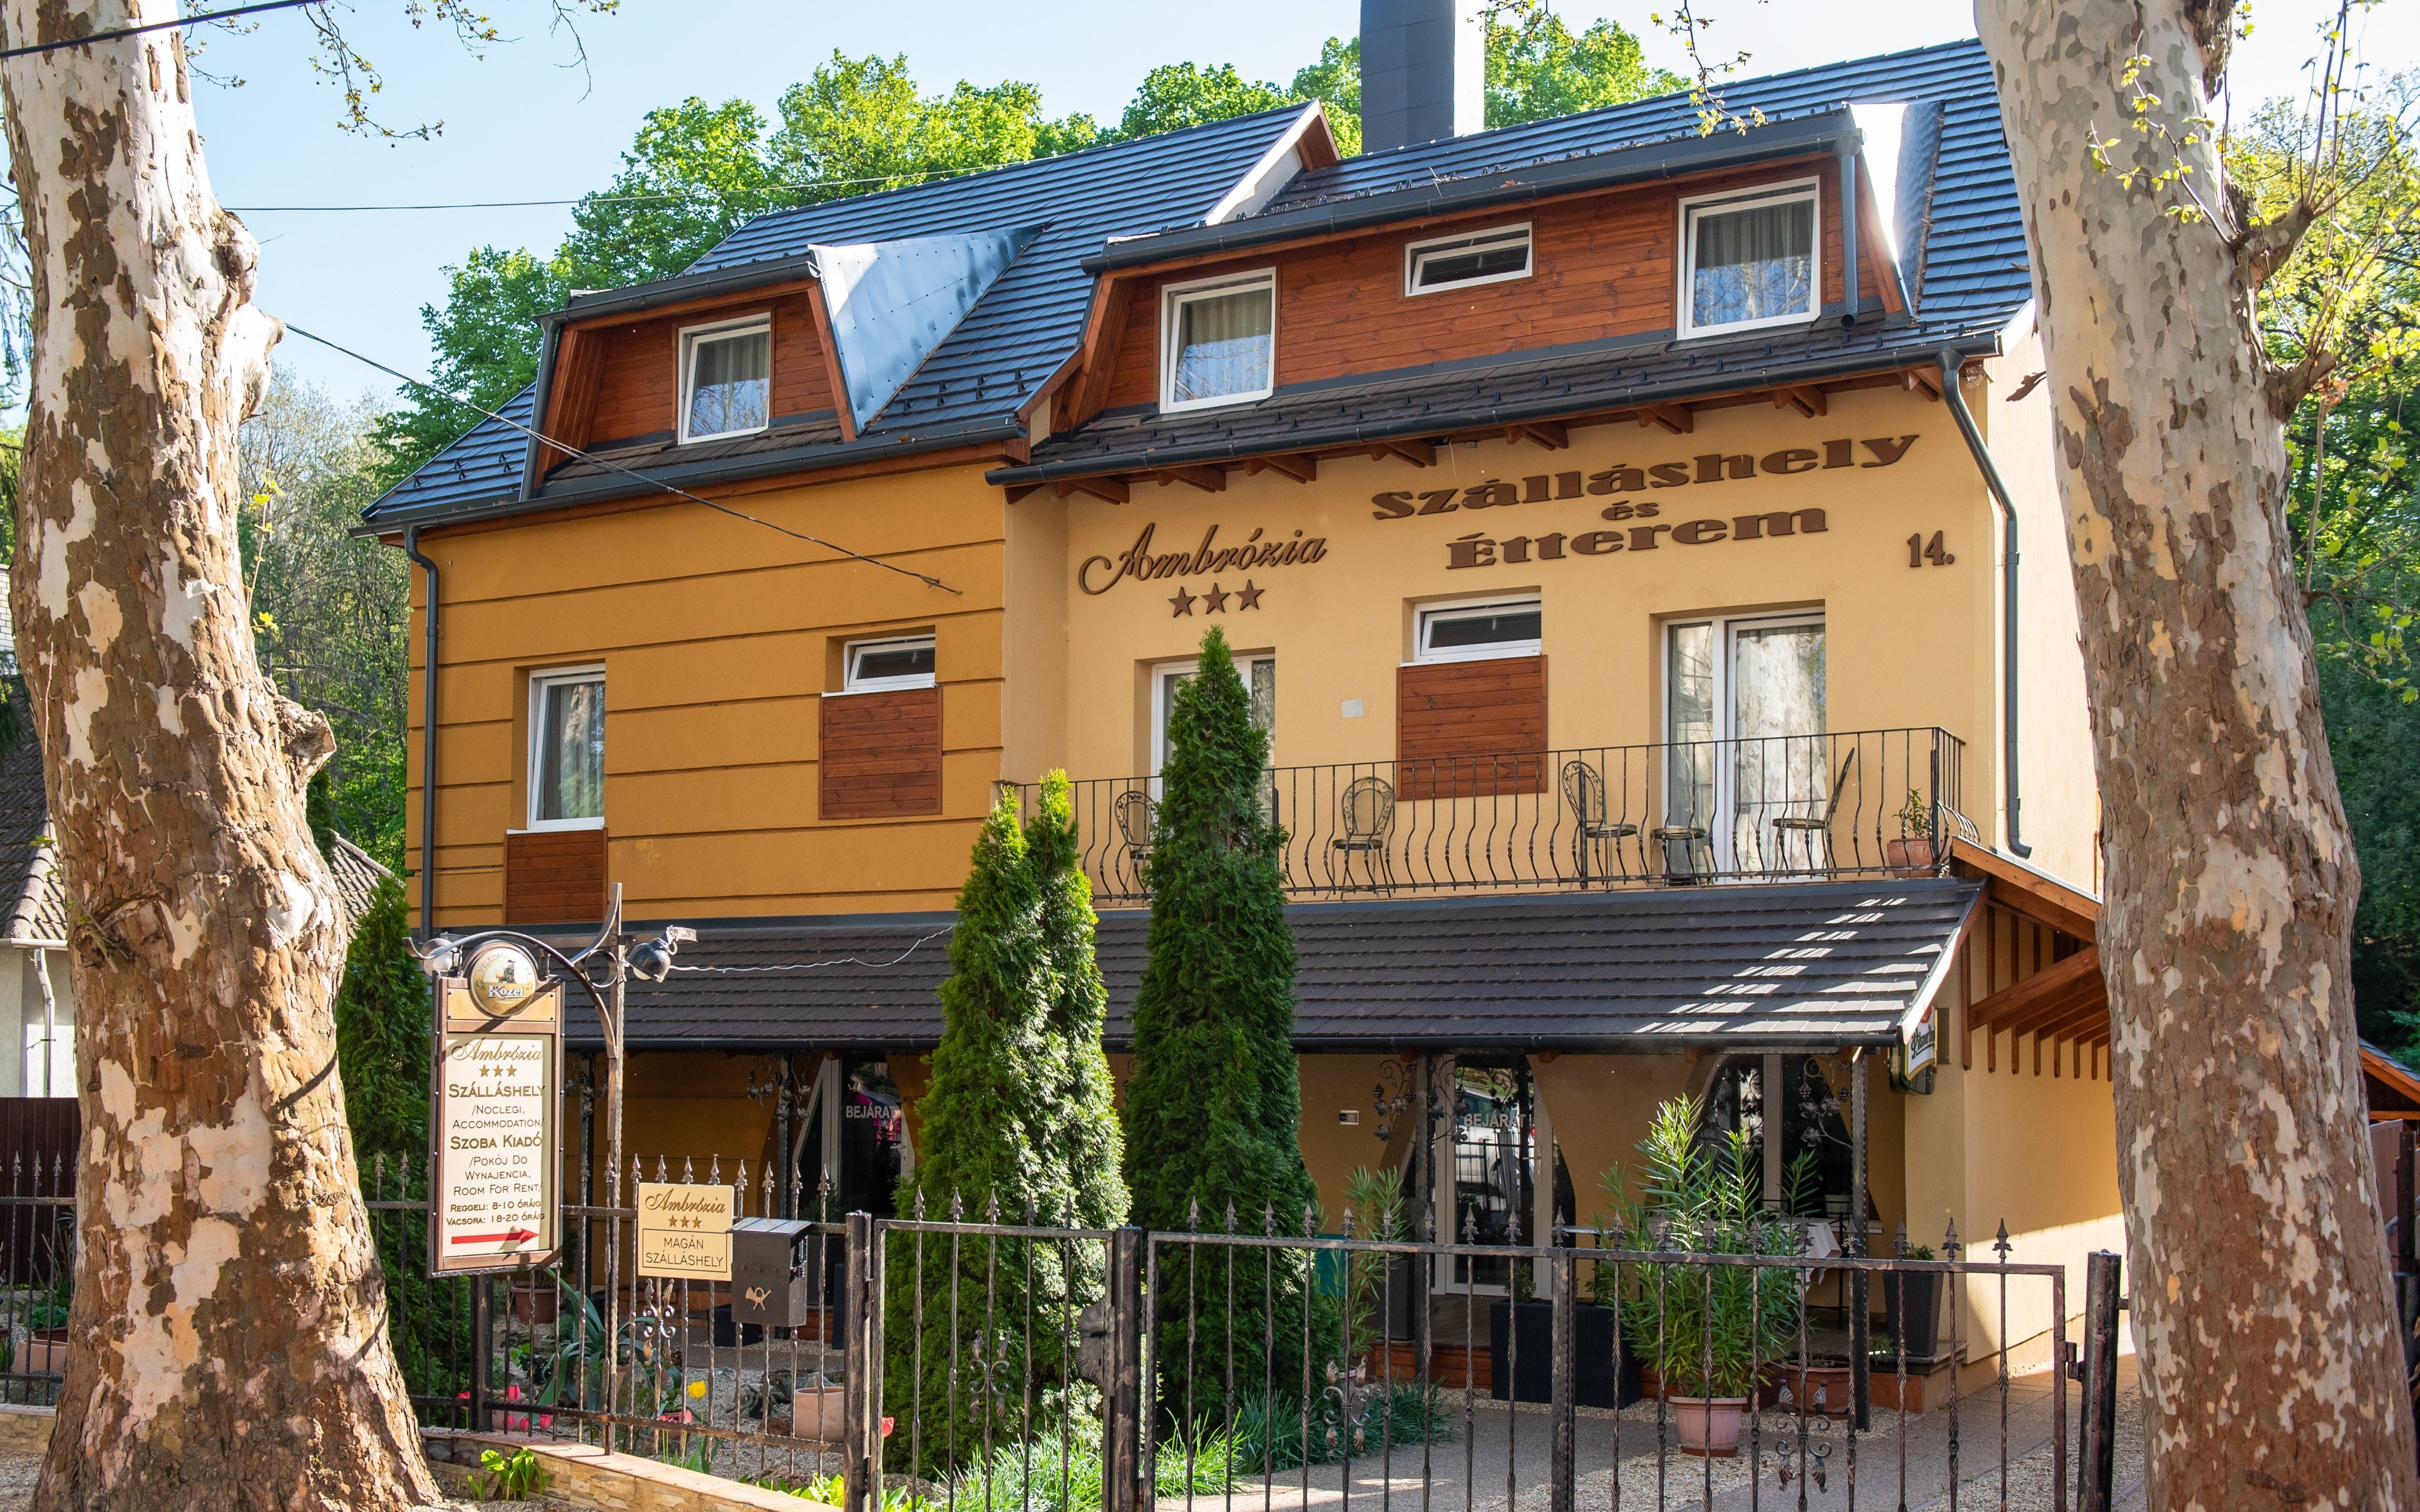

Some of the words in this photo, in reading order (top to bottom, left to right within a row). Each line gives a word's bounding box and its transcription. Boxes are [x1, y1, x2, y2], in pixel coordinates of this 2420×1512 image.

[1371, 434, 1920, 520] Szálláshely
[1601, 500, 1659, 520] és
[1446, 508, 1829, 569] Étterem
[1078, 522, 1328, 595] Ambrózia
[1907, 530, 1954, 568] 14.
[487, 985, 526, 999] Kozel
[451, 1037, 543, 1061] Ambrózia
[845, 1103, 896, 1119] BEJÁRAT
[1463, 1109, 1526, 1128] BEJÁRAT
[492, 1201, 515, 1210] 8-10
[645, 1188, 726, 1214] Ambrózia
[491, 1214, 519, 1223] 18-20
[664, 1234, 704, 1250] MAGÁN
[646, 1249, 724, 1267] SZÁLLÁSHELY
